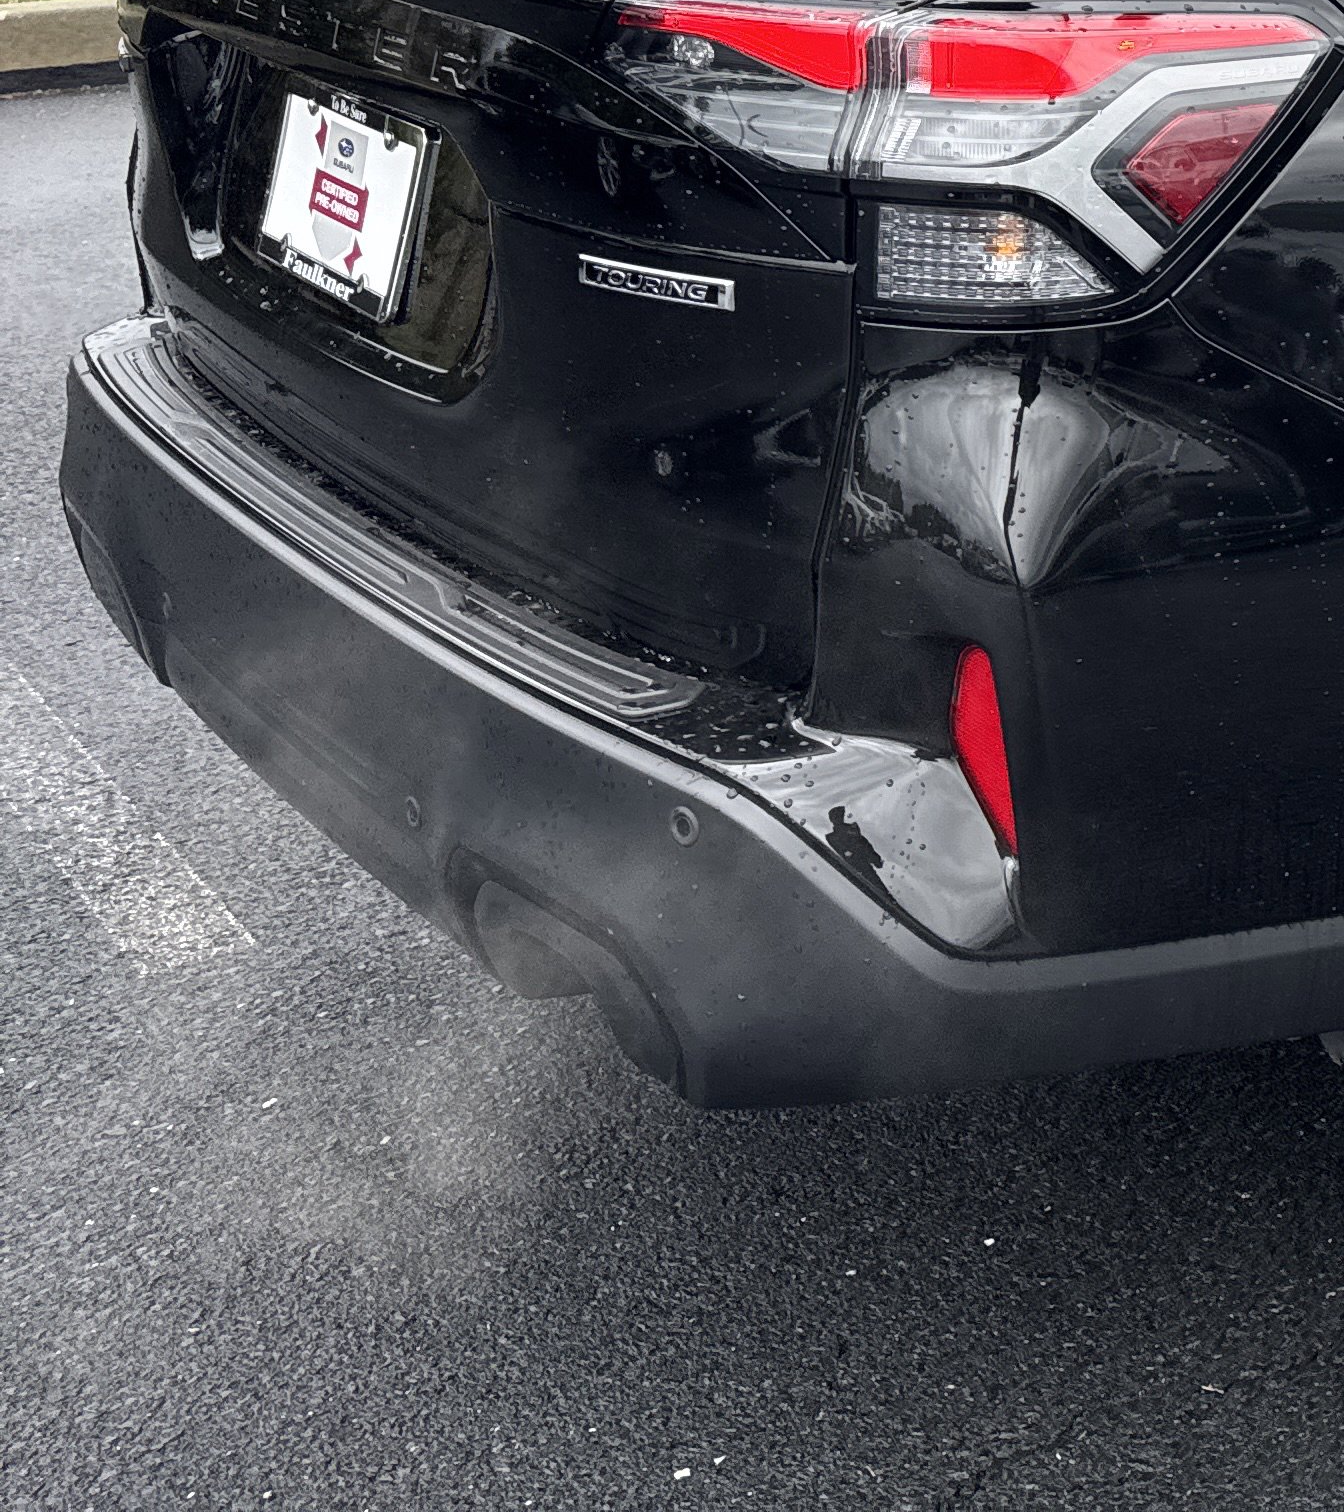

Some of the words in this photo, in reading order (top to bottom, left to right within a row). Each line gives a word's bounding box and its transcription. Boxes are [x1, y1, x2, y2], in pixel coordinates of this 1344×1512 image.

[330, 94, 340, 110] To
[340, 99, 350, 118] Be
[349, 104, 368, 124] Sure
[321, 178, 359, 206] CERTIFIED
[314, 195, 360, 224] PRE-OWNED
[281, 248, 355, 303] Faulkner
[592, 265, 709, 301] TOURING
